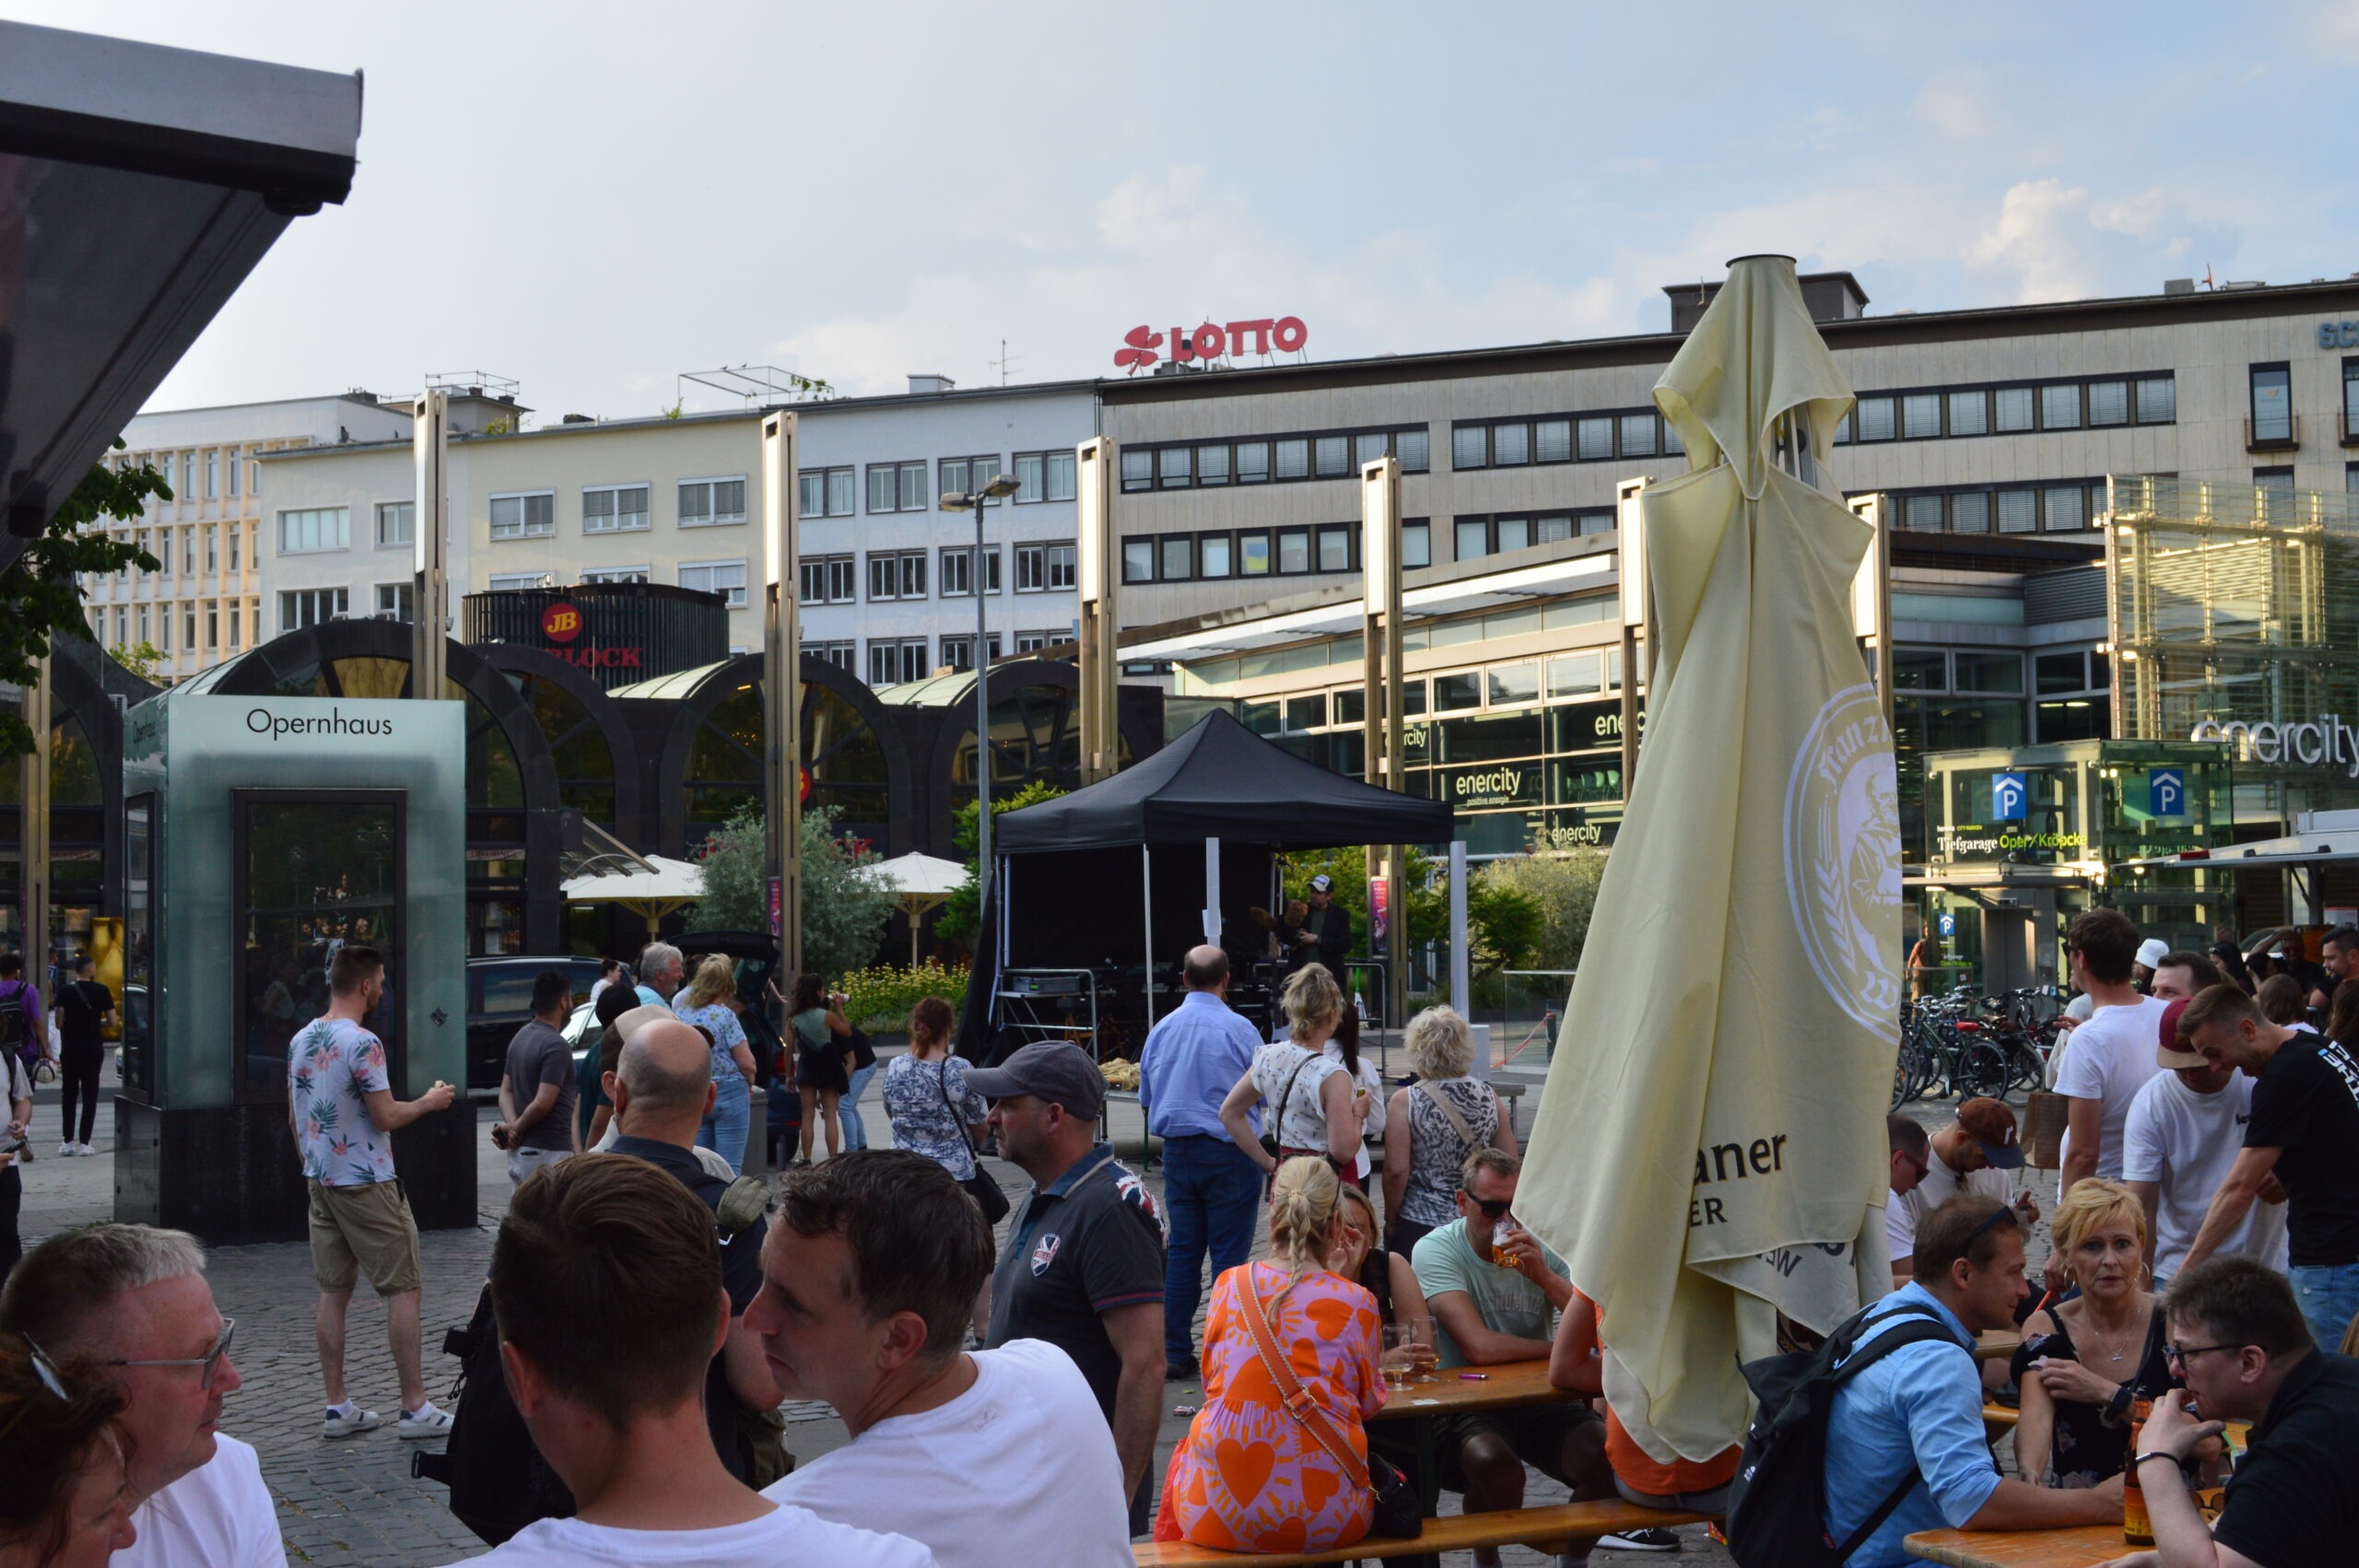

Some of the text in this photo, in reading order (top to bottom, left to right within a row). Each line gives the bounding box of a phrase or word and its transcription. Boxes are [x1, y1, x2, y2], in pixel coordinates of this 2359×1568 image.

[1170, 316, 1308, 362] LOTTO
[2318, 320, 2359, 348] SC
[547, 612, 576, 633] JB
[247, 707, 393, 741] Opernhaus
[1456, 766, 1520, 796] enercity
[1467, 794, 1509, 807] positive energie
[2003, 786, 2018, 817] P
[2161, 785, 2177, 813] P
[1552, 824, 1602, 844] enercity
[1937, 835, 1999, 855] Tiefgarage
